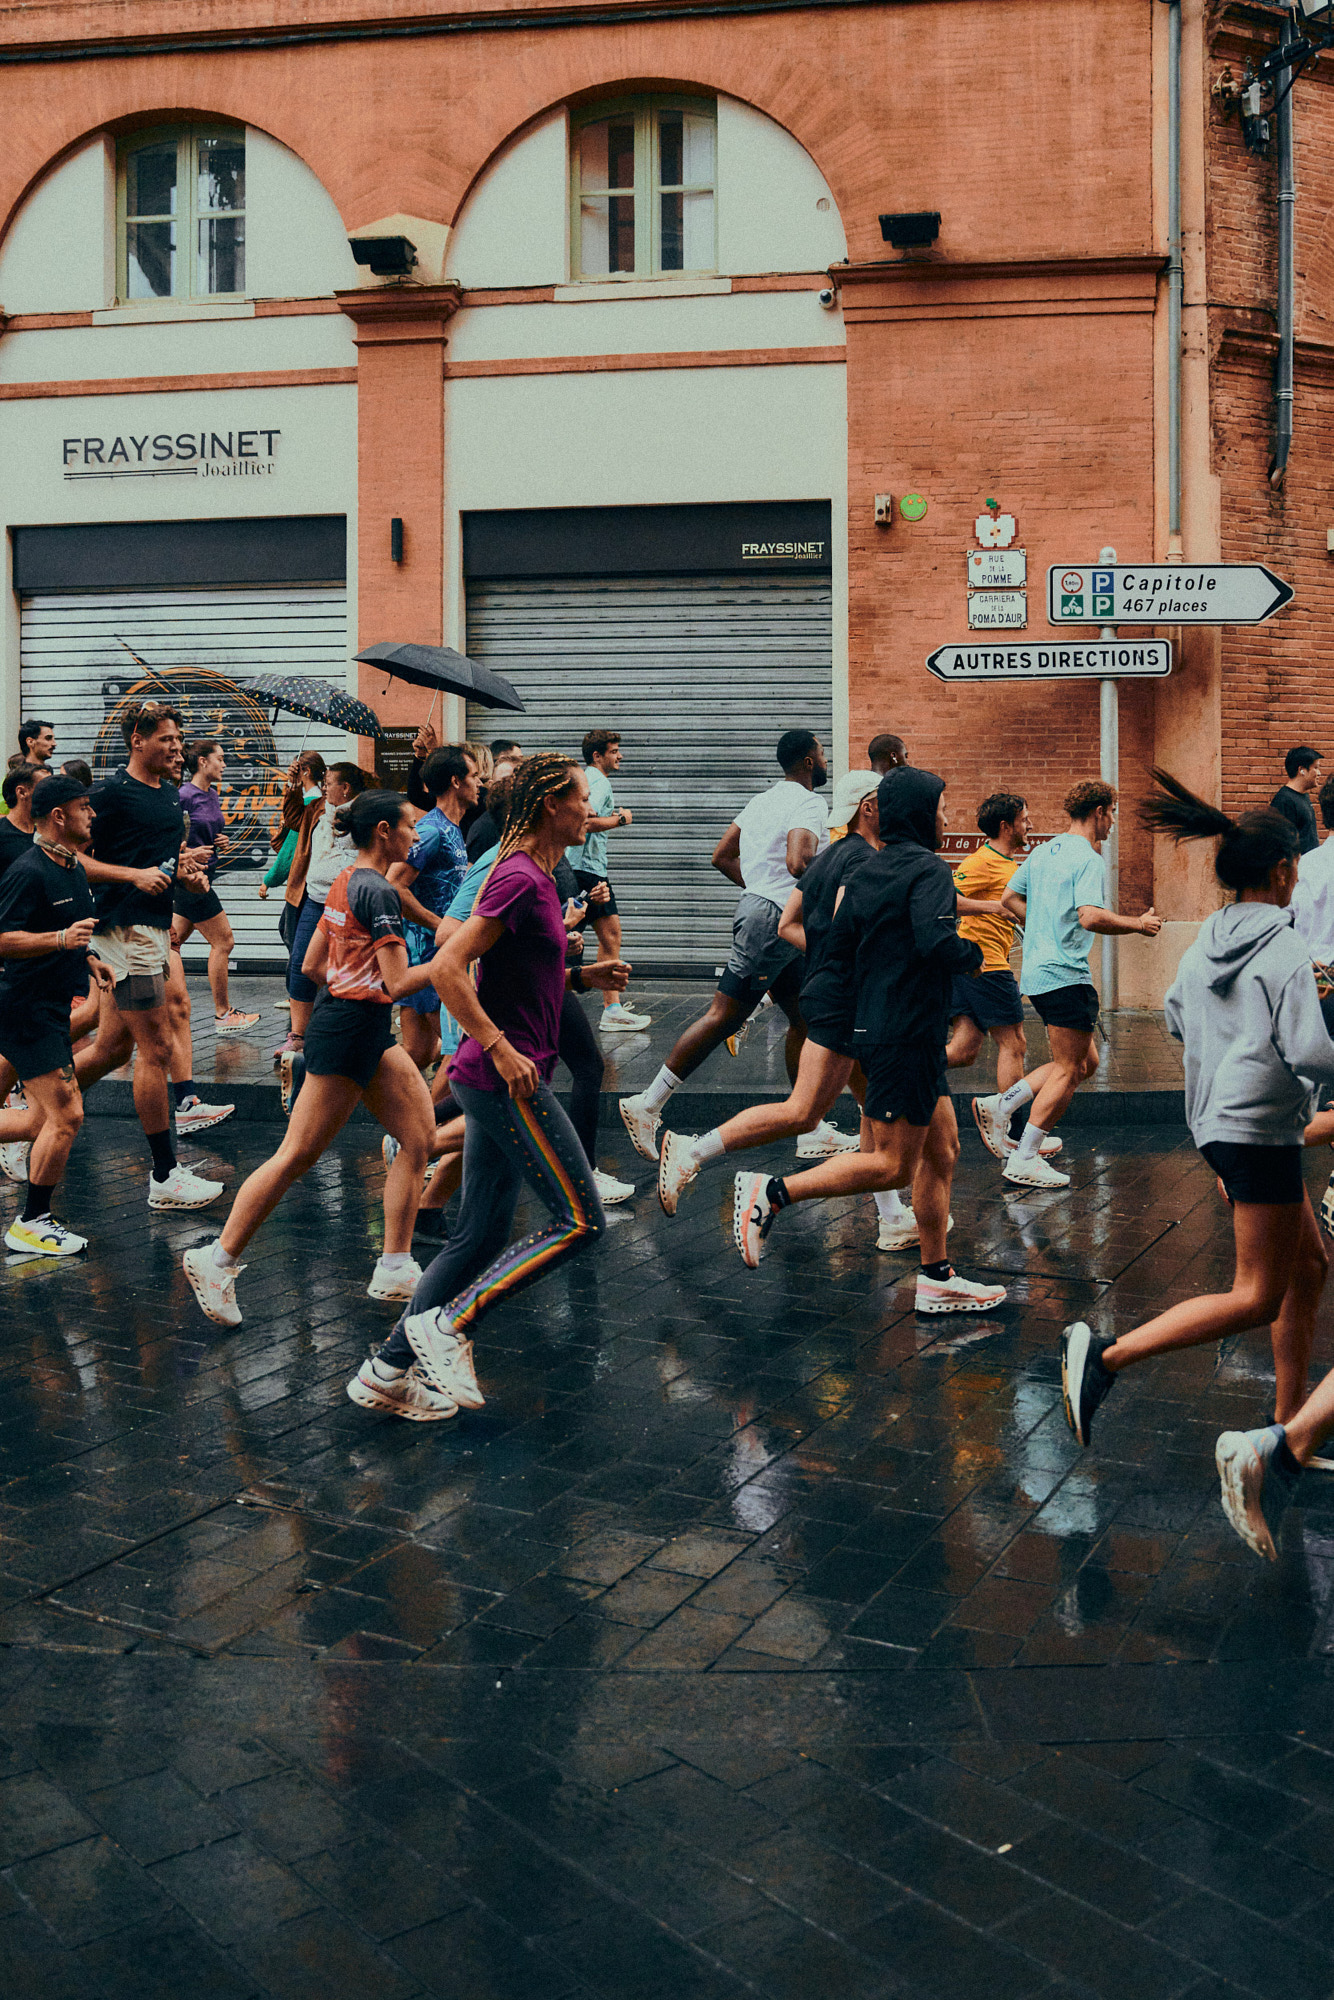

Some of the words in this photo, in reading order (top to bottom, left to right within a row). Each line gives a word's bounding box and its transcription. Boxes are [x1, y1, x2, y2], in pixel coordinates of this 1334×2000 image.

[63, 430, 281, 465] FRAYSSINET
[202, 461, 275, 478] Joaillier
[741, 541, 825, 555] FRAYSSINET
[988, 555, 1005, 563] RUE
[981, 573, 1012, 584] POMME
[1122, 574, 1217, 595] Capitole
[979, 595, 1016, 603] CARRIERA
[1122, 598, 1155, 612] 467
[1158, 598, 1208, 616] places
[972, 614, 997, 624] POMA
[998, 613, 1022, 623] D'AUR
[953, 652, 1032, 671] AUTRES
[1038, 649, 1159, 669] DIRECTIONS
